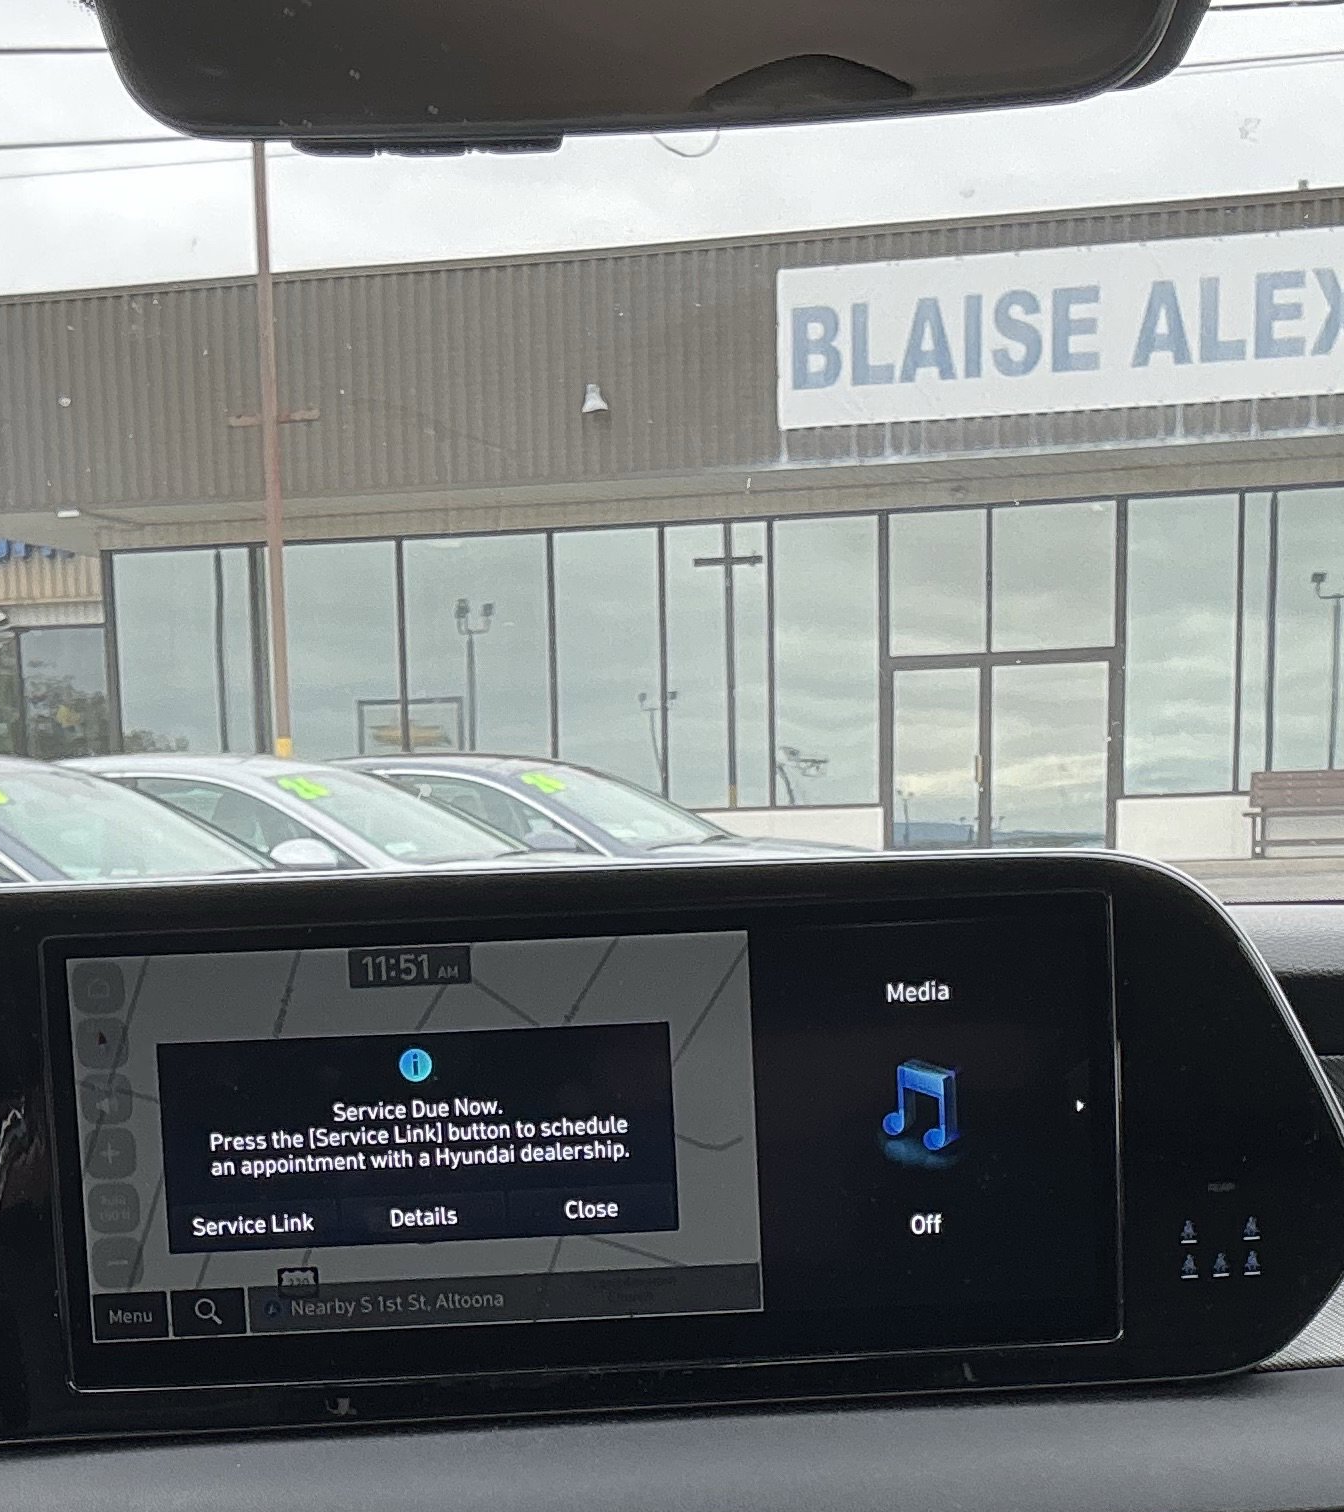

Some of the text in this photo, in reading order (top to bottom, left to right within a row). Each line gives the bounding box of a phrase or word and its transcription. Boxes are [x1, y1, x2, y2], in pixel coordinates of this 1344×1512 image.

[791, 286, 1101, 391] BLAISE
[361, 954, 460, 983] 11:51 AM
[885, 981, 951, 1003] Media
[332, 1097, 505, 1122] Service Due Now.
[209, 1115, 629, 1152] Press the [Service Link] button to schedule
[210, 1139, 631, 1180] an appointment with a Hyundai dealership.
[389, 1206, 459, 1228] Details
[564, 1199, 619, 1221] Close
[192, 1212, 315, 1237] Service Link
[910, 1213, 943, 1235] Off
[108, 1308, 153, 1325] Menu
[291, 1297, 356, 1318] Nearby
[360, 1296, 373, 1313] S
[376, 1294, 403, 1312] 1st
[436, 1291, 505, 1309] Altoona
